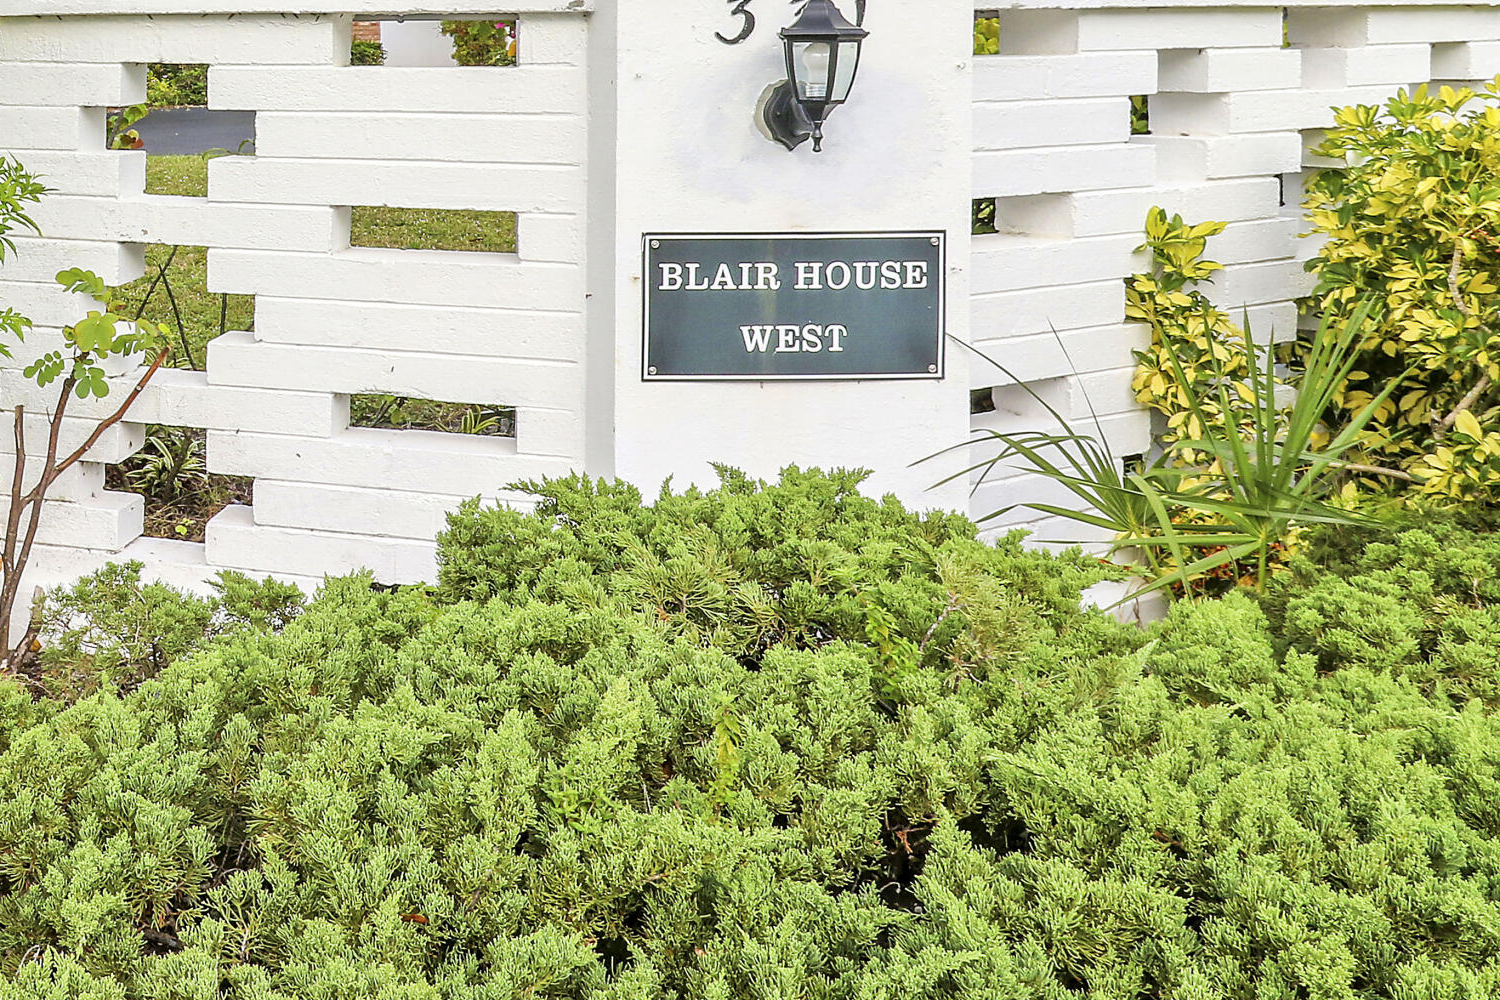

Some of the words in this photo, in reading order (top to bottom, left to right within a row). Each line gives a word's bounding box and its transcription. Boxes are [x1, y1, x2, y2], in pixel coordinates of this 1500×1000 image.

[658, 262, 781, 290] BLAIR
[794, 260, 928, 290] HOUSE
[739, 324, 848, 353] WEST
